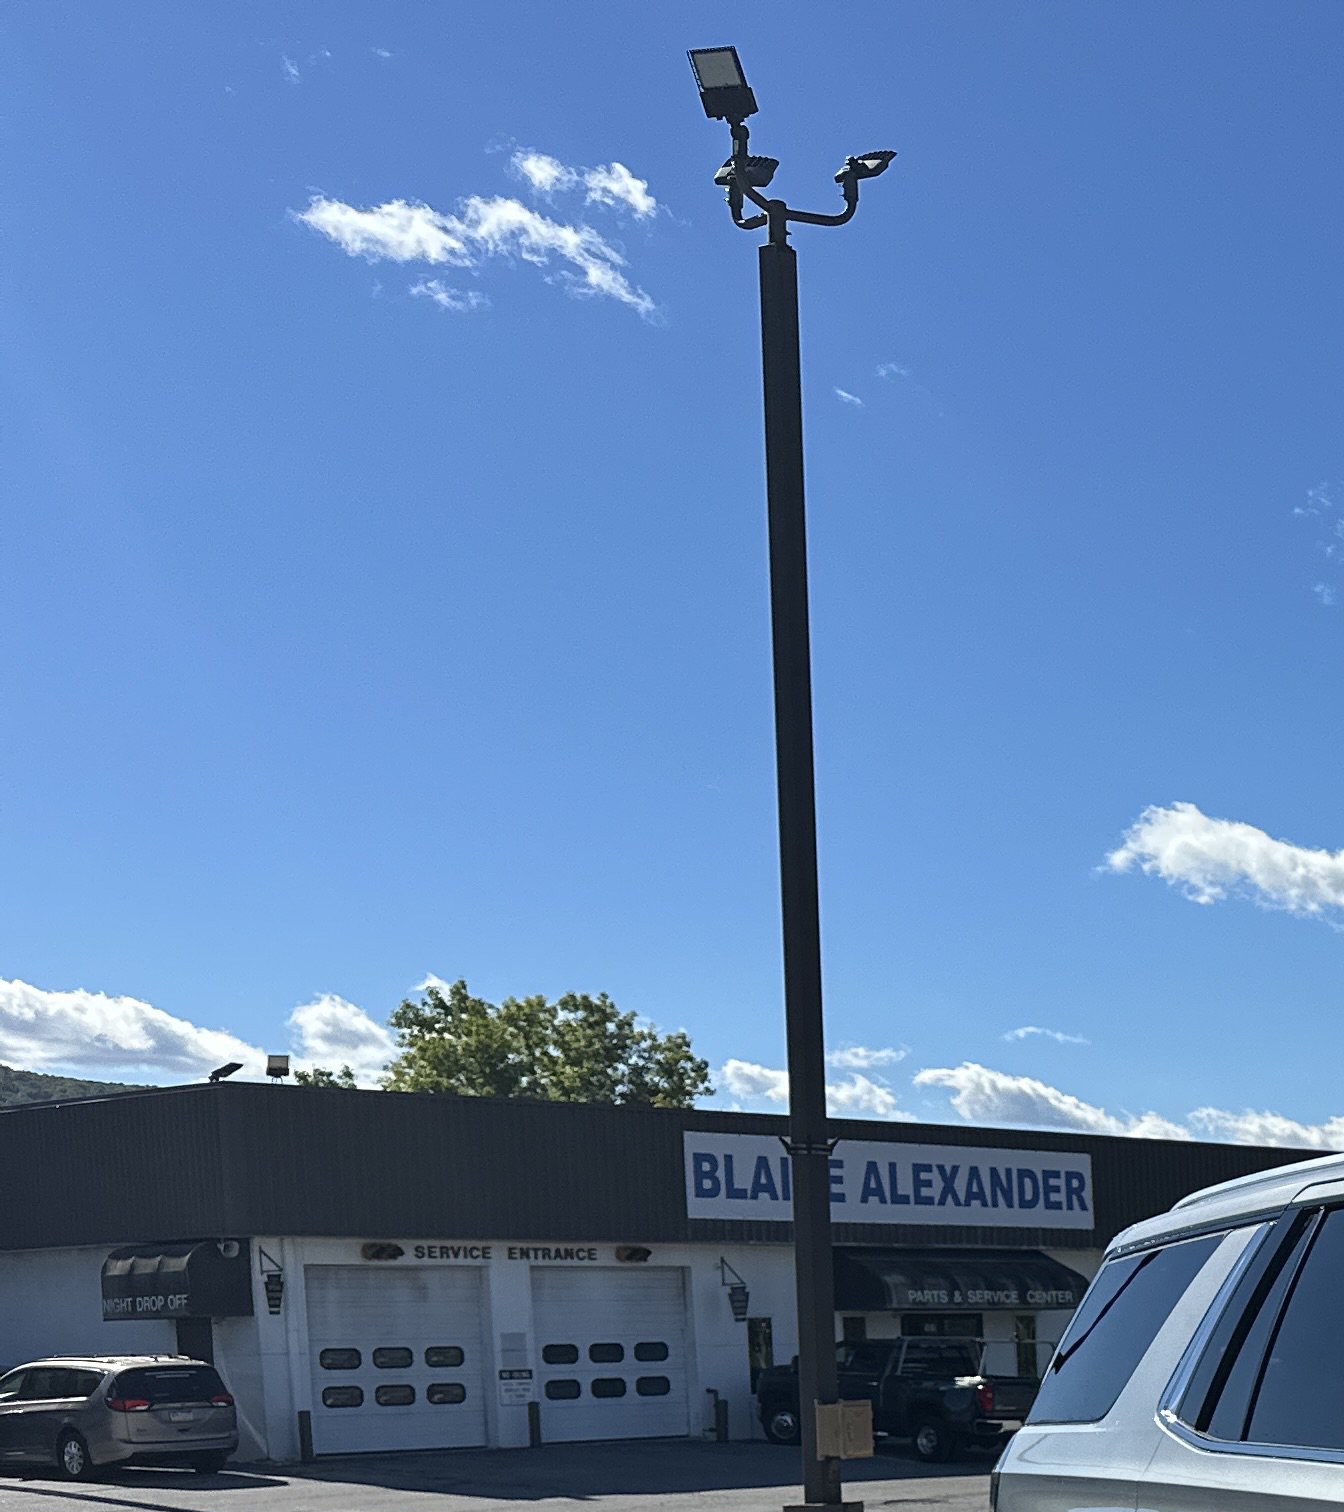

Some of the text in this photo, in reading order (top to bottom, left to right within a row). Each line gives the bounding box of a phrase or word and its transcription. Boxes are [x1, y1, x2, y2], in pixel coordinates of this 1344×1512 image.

[692, 1152, 1089, 1212] BLAIE ALEXANDER
[414, 1245, 597, 1261] SERVICE ENTRANCE
[103, 1293, 189, 1313] NIGHT DROP OFF
[907, 1289, 1073, 1304] PARTS & SERVICE CENTER
